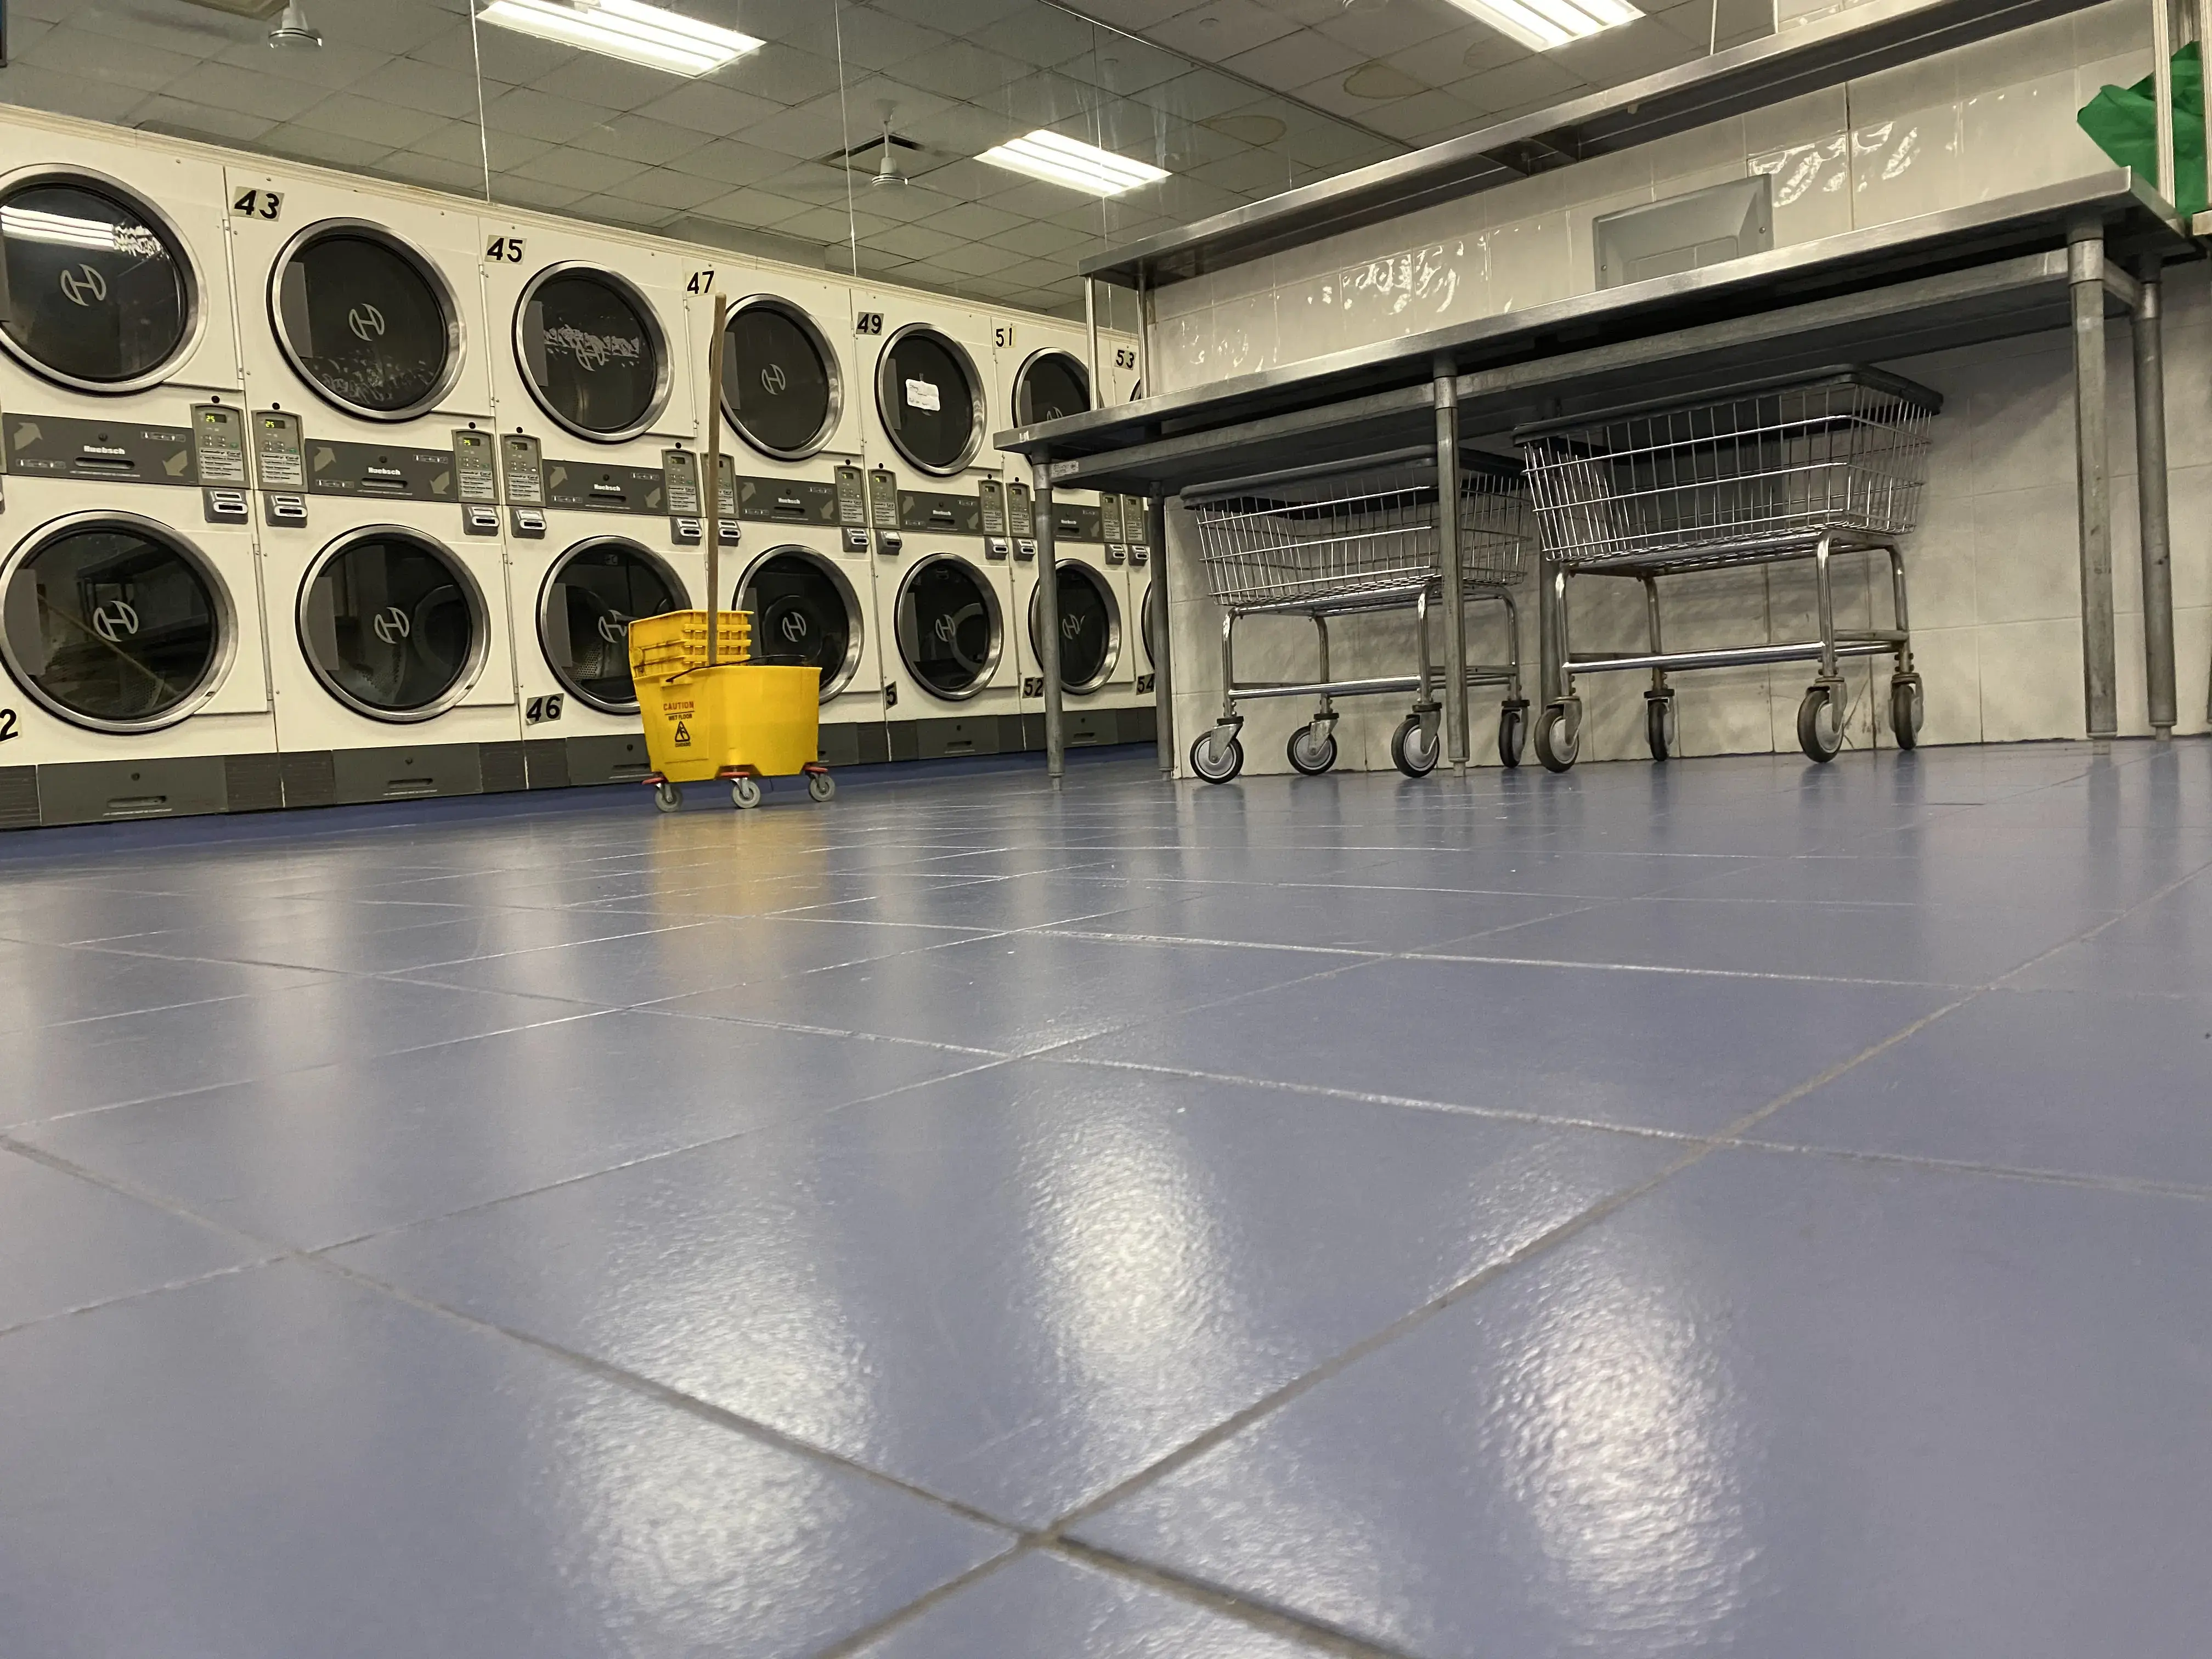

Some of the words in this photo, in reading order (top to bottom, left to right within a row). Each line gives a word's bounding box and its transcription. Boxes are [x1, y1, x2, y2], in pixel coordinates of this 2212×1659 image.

[234, 190, 280, 219] 43
[487, 238, 523, 263] 45
[687, 270, 714, 295] 47
[857, 313, 882, 335] 49
[995, 328, 1012, 347] 51
[1116, 349, 1135, 369] 53
[206, 415, 215, 423] 25
[266, 420, 275, 428] 25
[1024, 678, 1044, 697] 52
[1137, 674, 1155, 693] 54
[885, 683, 897, 706] 5
[526, 695, 561, 723] 46
[663, 701, 695, 711] CAUTION
[0, 708, 18, 742] 2
